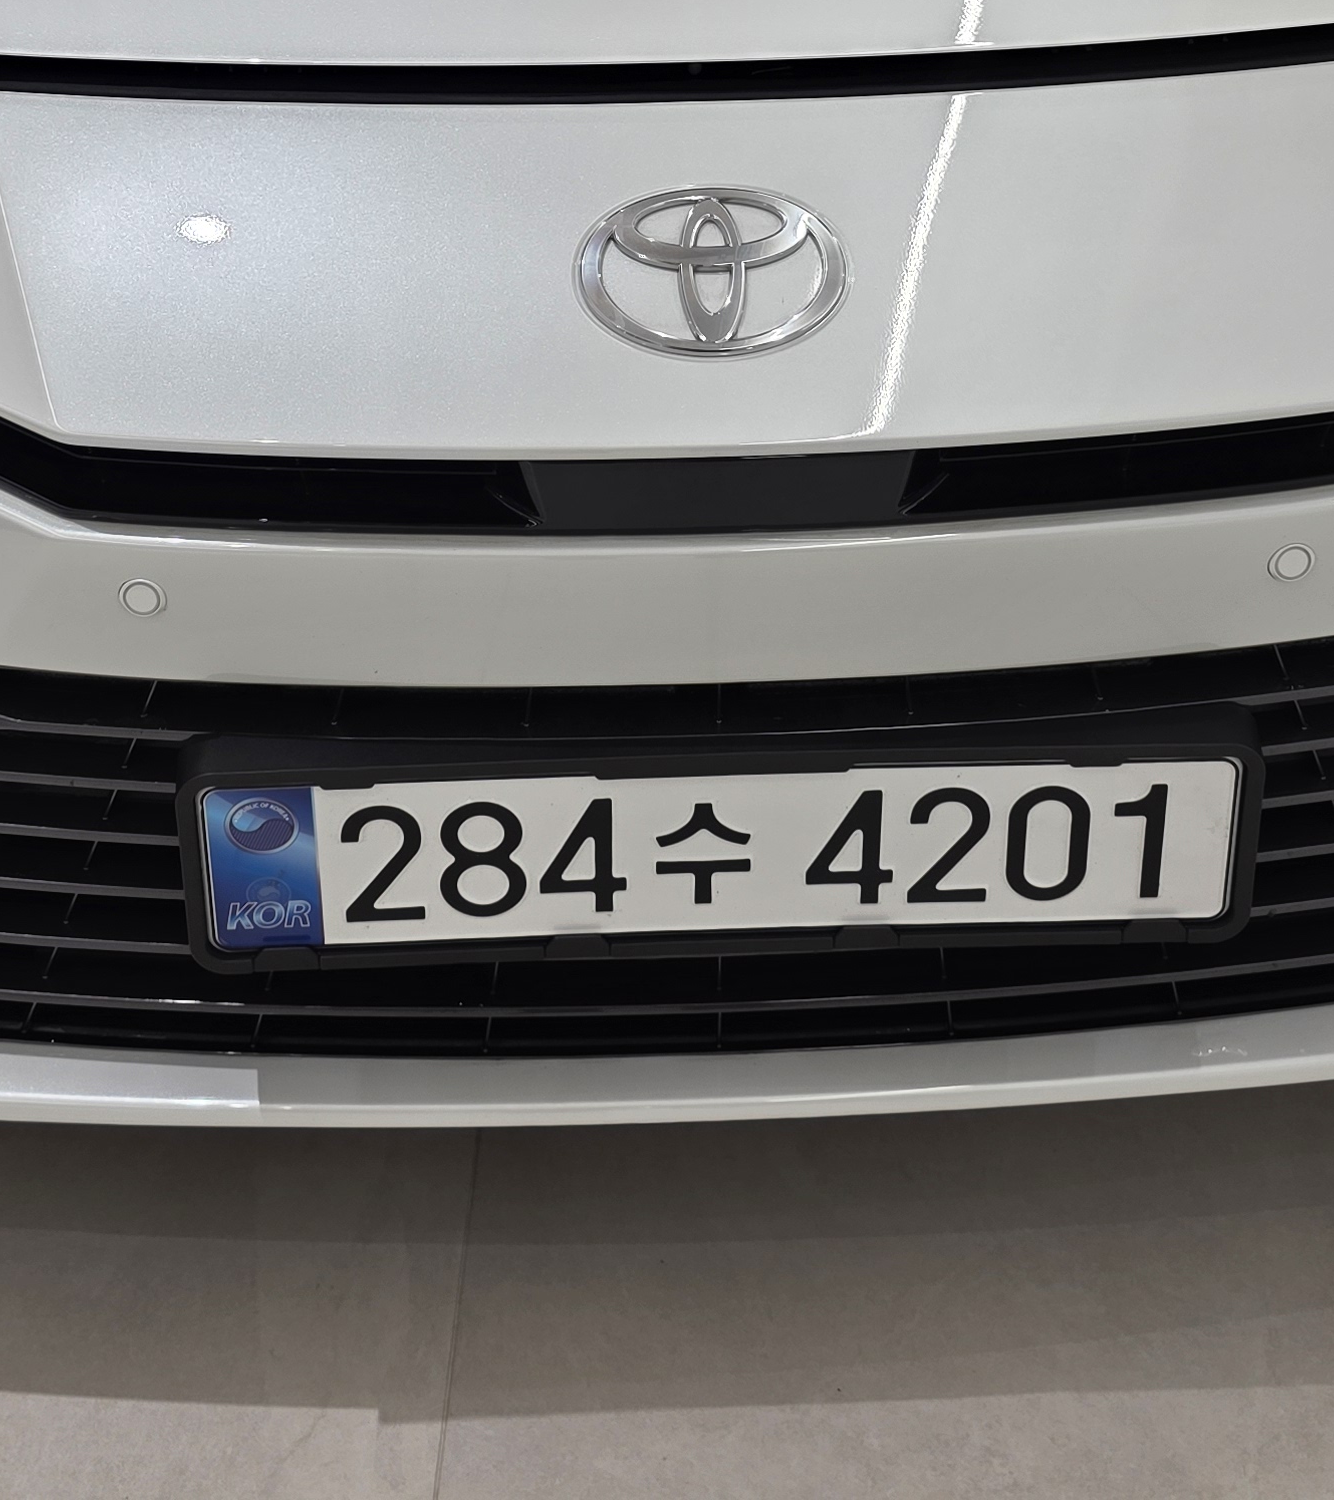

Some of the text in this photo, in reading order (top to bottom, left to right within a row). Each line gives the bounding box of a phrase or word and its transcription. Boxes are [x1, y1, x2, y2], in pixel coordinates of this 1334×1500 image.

[338, 783, 1170, 923] 284수 4201
[226, 900, 312, 930] KOR
